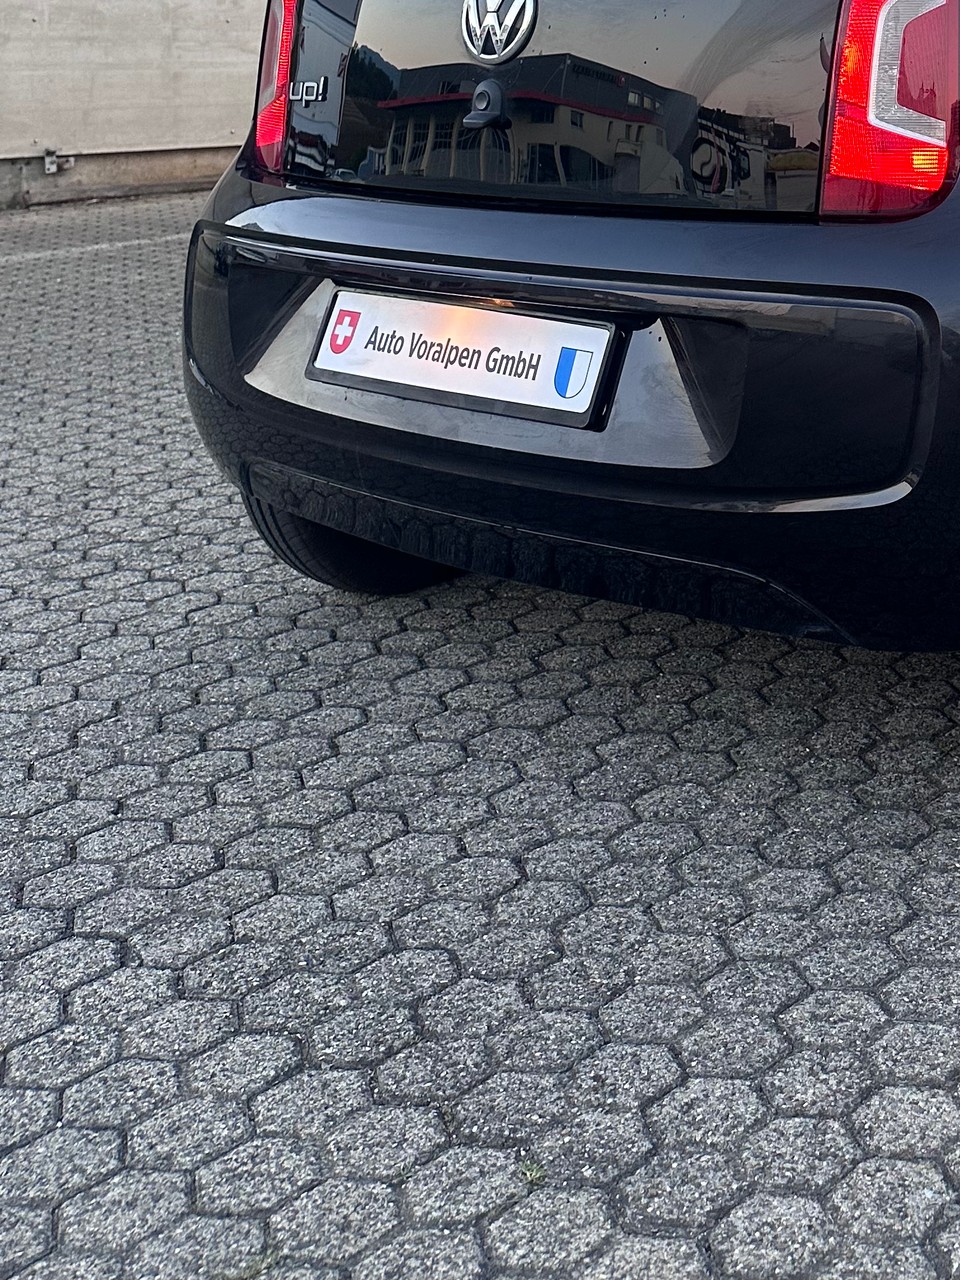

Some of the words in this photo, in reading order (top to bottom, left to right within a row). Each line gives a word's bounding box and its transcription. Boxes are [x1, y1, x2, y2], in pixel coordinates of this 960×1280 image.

[289, 75, 327, 108] up!
[364, 325, 404, 353] Auto
[408, 332, 482, 370] Voralpen
[485, 346, 542, 381] GmbH
